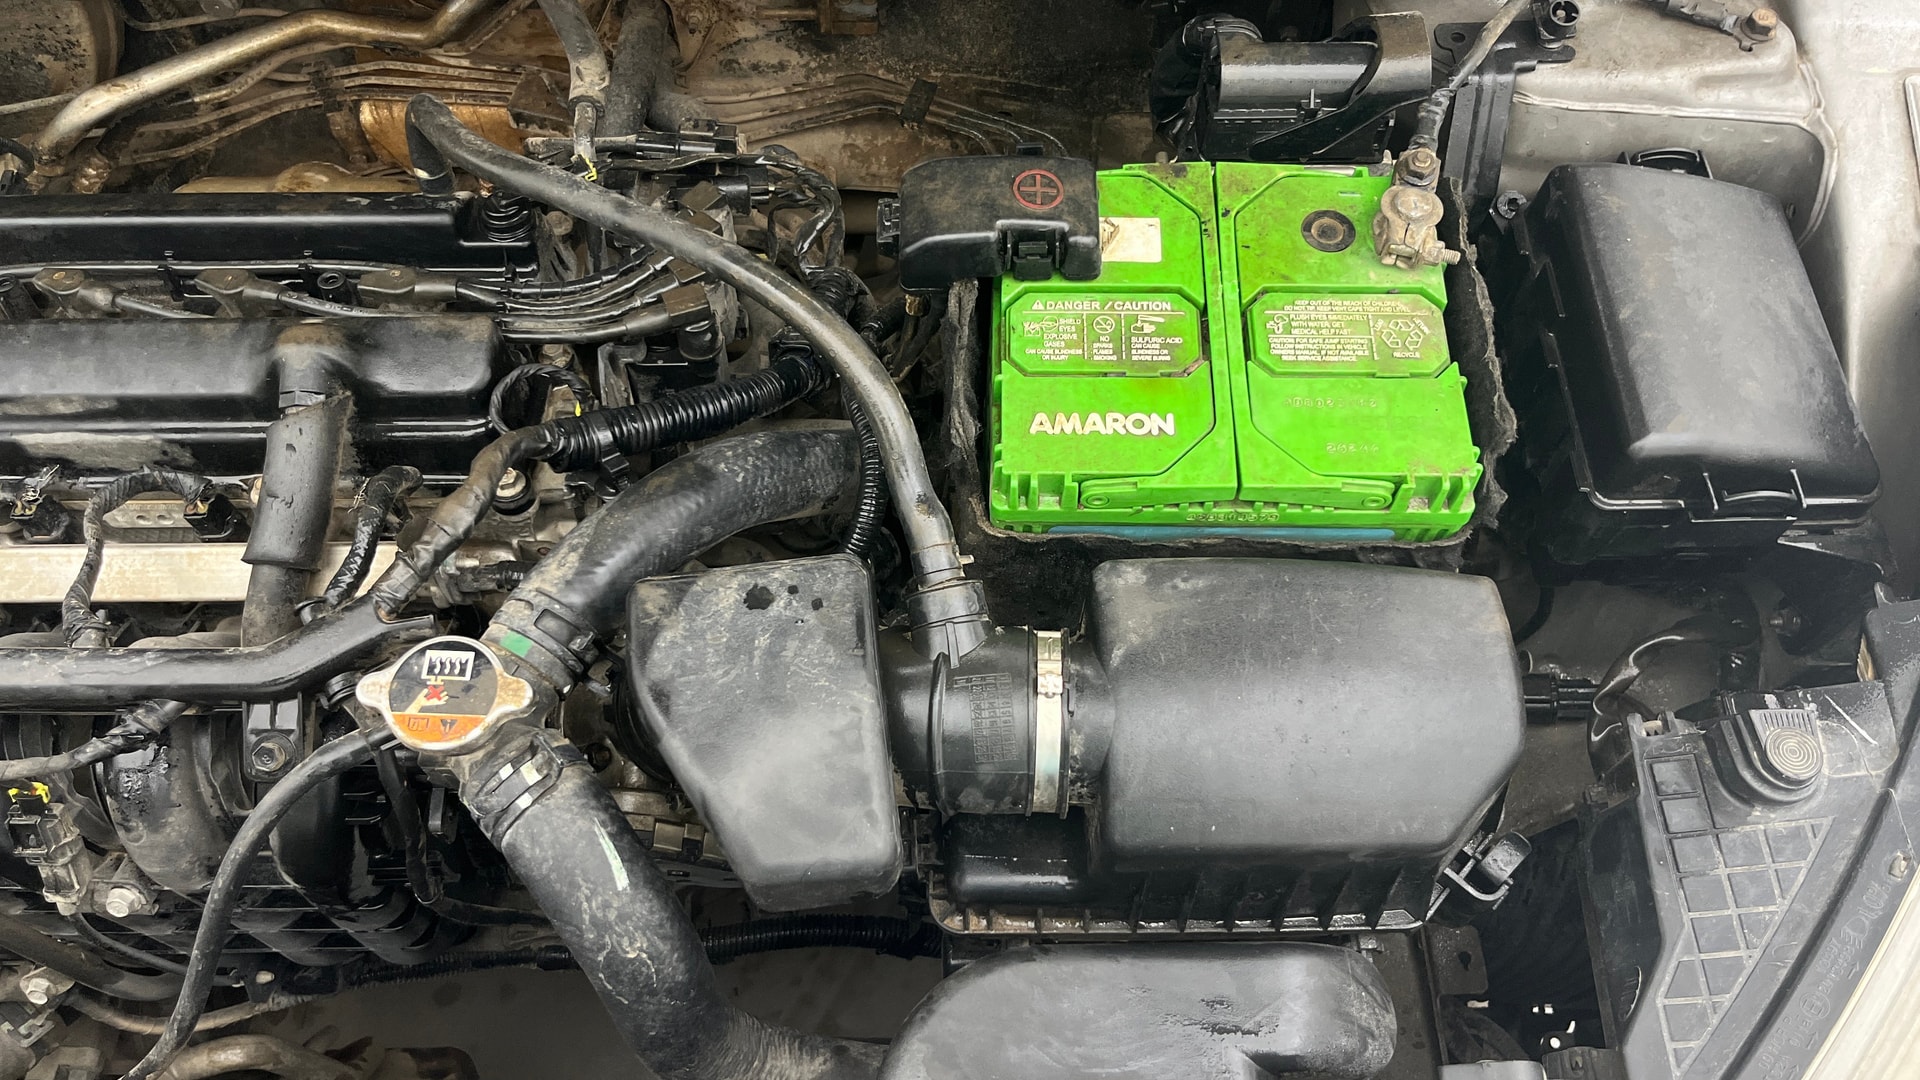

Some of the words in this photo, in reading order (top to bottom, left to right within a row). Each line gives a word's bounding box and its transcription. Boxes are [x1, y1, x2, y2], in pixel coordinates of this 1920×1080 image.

[1046, 301, 1100, 310] DANGER
[1114, 301, 1171, 310] CAUTION
[1030, 412, 1175, 436] AMARON
